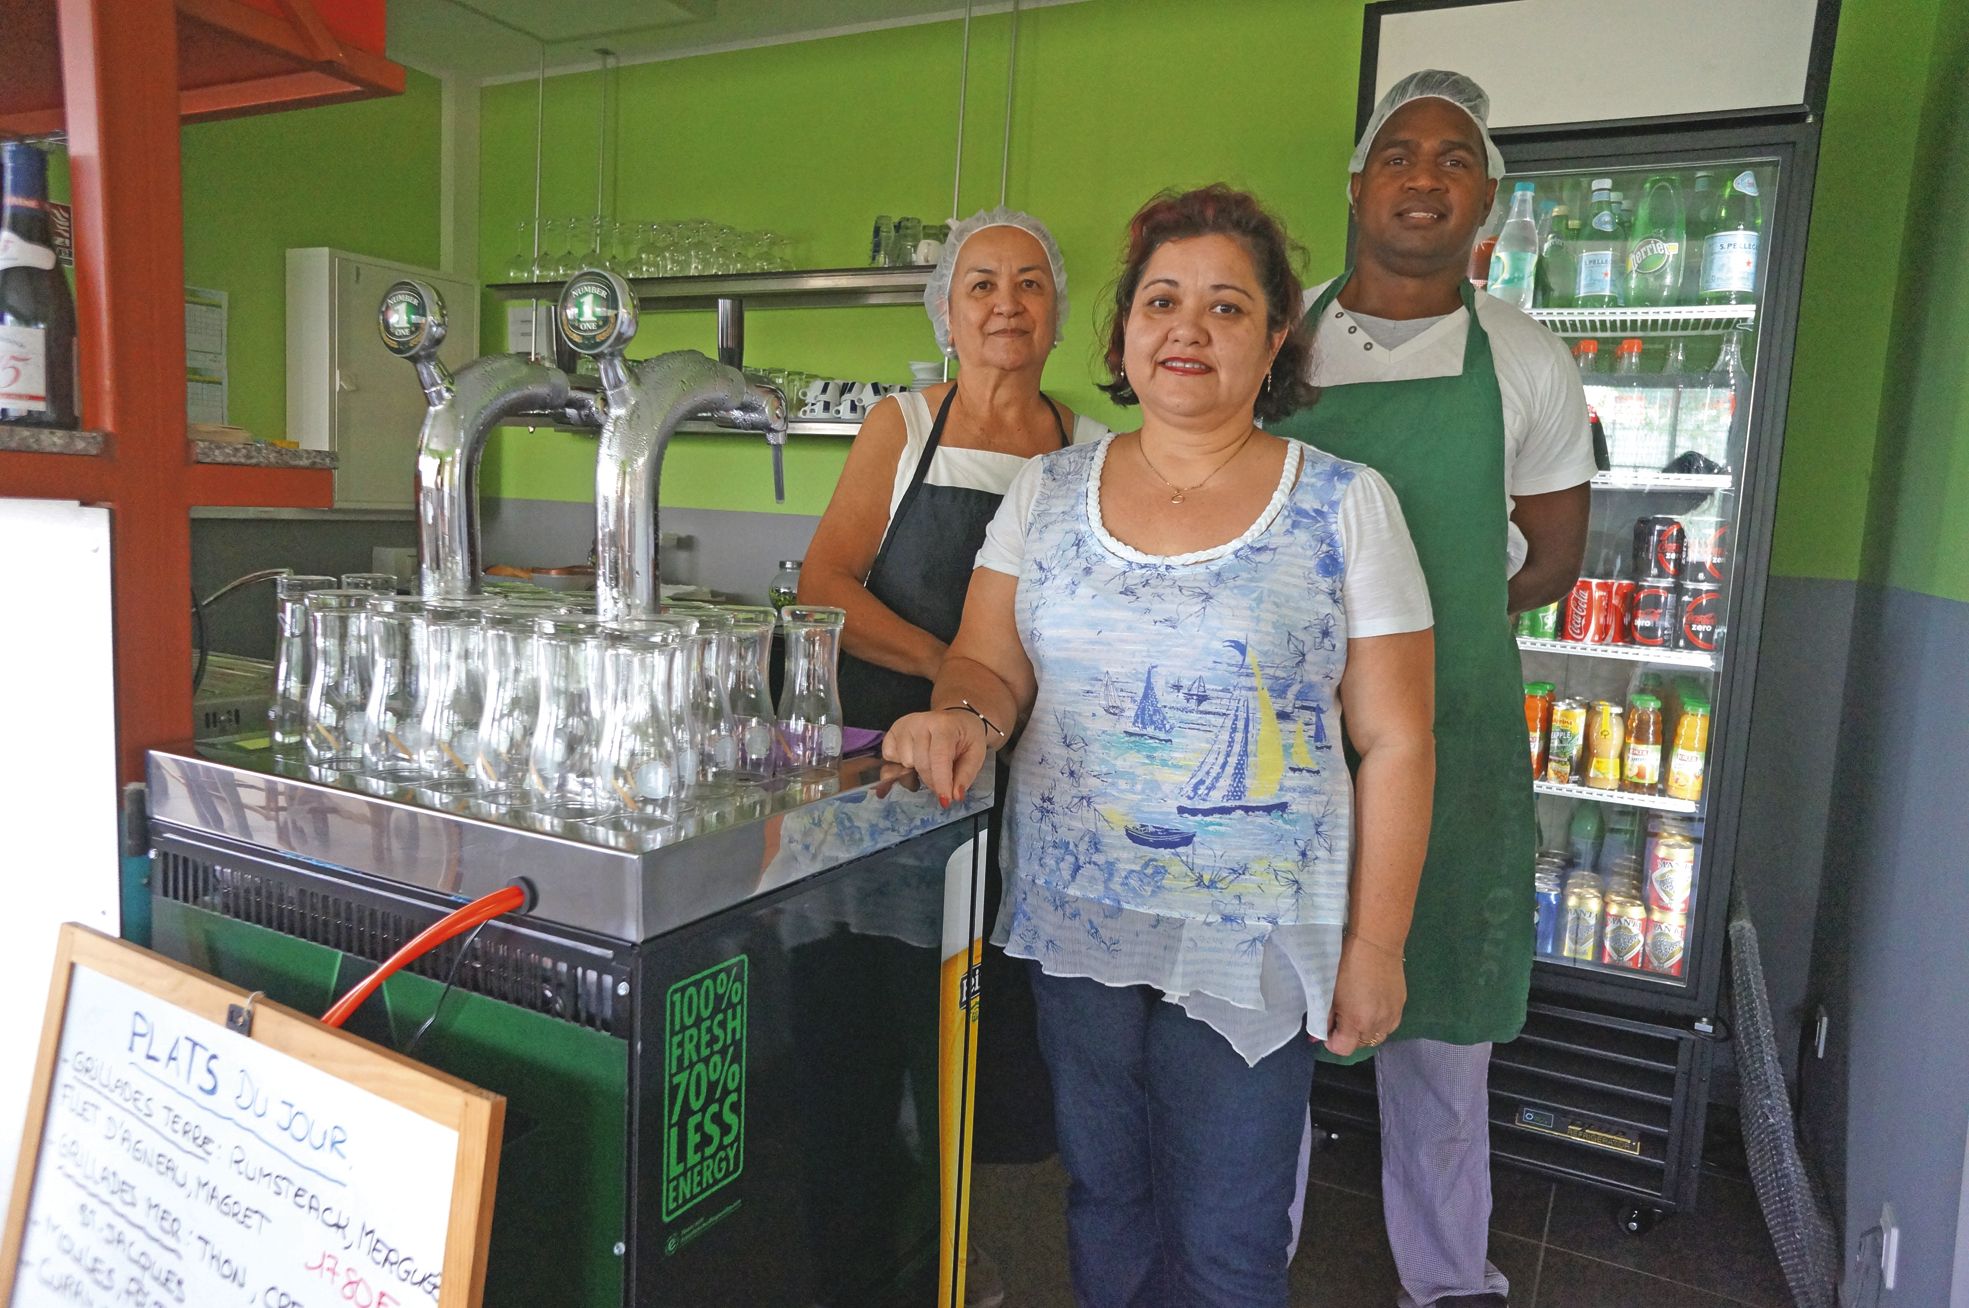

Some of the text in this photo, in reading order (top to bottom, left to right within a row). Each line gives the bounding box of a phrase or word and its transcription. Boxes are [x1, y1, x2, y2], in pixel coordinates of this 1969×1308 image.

[387, 294, 419, 306] NUMBER
[571, 285, 608, 299] NUMBER
[394, 302, 410, 328] 1
[580, 294, 597, 321] 1
[395, 328, 410, 336] ONE
[580, 322, 598, 331] ONE
[1691, 623, 1713, 632] zero
[672, 966, 741, 1031] 100%
[671, 1004, 741, 1074] FRESH
[127, 1010, 220, 1096] PLATS
[234, 1068, 269, 1118] DU
[671, 1046, 740, 1124] 70%
[669, 1092, 739, 1179] LESS
[668, 1142, 738, 1211] ENERGY
